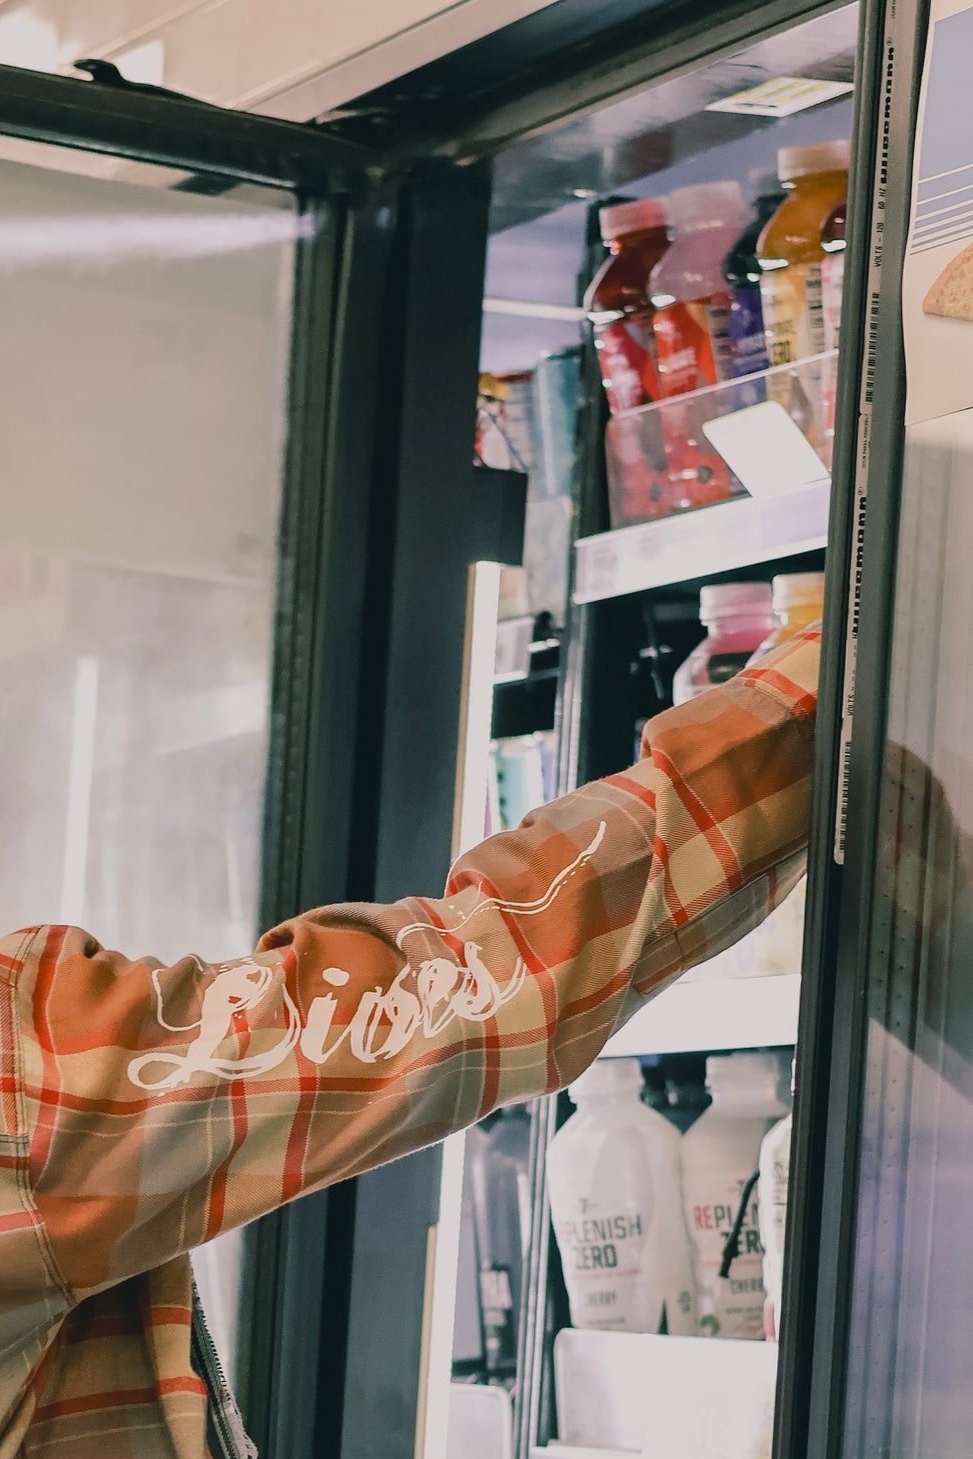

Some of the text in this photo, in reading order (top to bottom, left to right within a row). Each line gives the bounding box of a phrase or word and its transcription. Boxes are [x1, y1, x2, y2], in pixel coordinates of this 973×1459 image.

[877, 201, 886, 210] 60
[875, 222, 884, 233] 120
[873, 246, 883, 268] VOLTS
